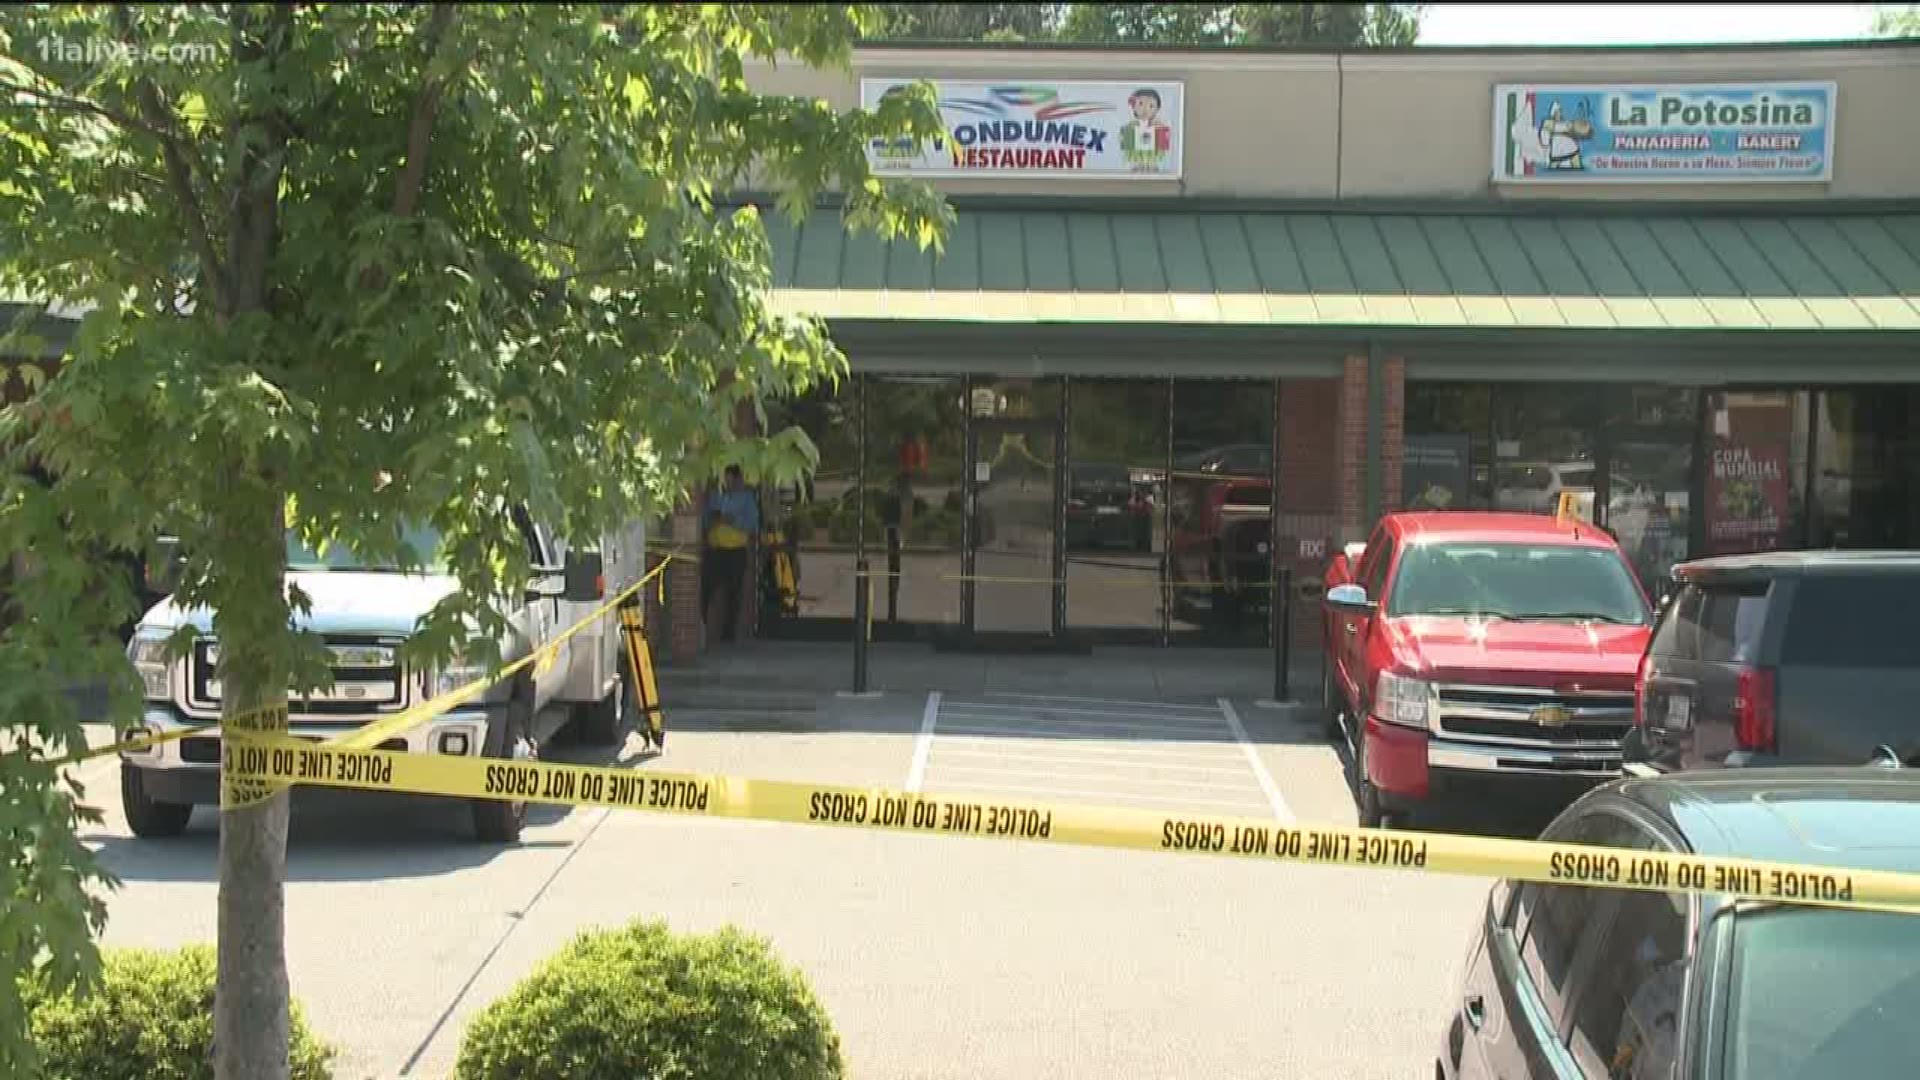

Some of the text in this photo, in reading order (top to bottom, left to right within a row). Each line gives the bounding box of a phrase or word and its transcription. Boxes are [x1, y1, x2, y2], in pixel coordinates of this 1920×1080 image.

[1610, 96, 1812, 127] La Potosina
[934, 119, 1107, 152] ONDUMEX
[1614, 134, 1801, 151] PANADERIA BAKERY
[1714, 449, 1752, 464] COPA
[238, 747, 268, 776] NOT
[272, 749, 294, 776] DO
[298, 750, 333, 780] LINE
[337, 752, 393, 783] POLICE
[485, 764, 709, 811] POLICE LINE DO NOT CROSS
[809, 791, 1052, 838] POLICE LINE DO NOT CROSS
[1161, 820, 1427, 868] POLICE LINE DO NOT CROSS
[1549, 851, 1853, 901] POLICE LINE DO NOT CROSS
